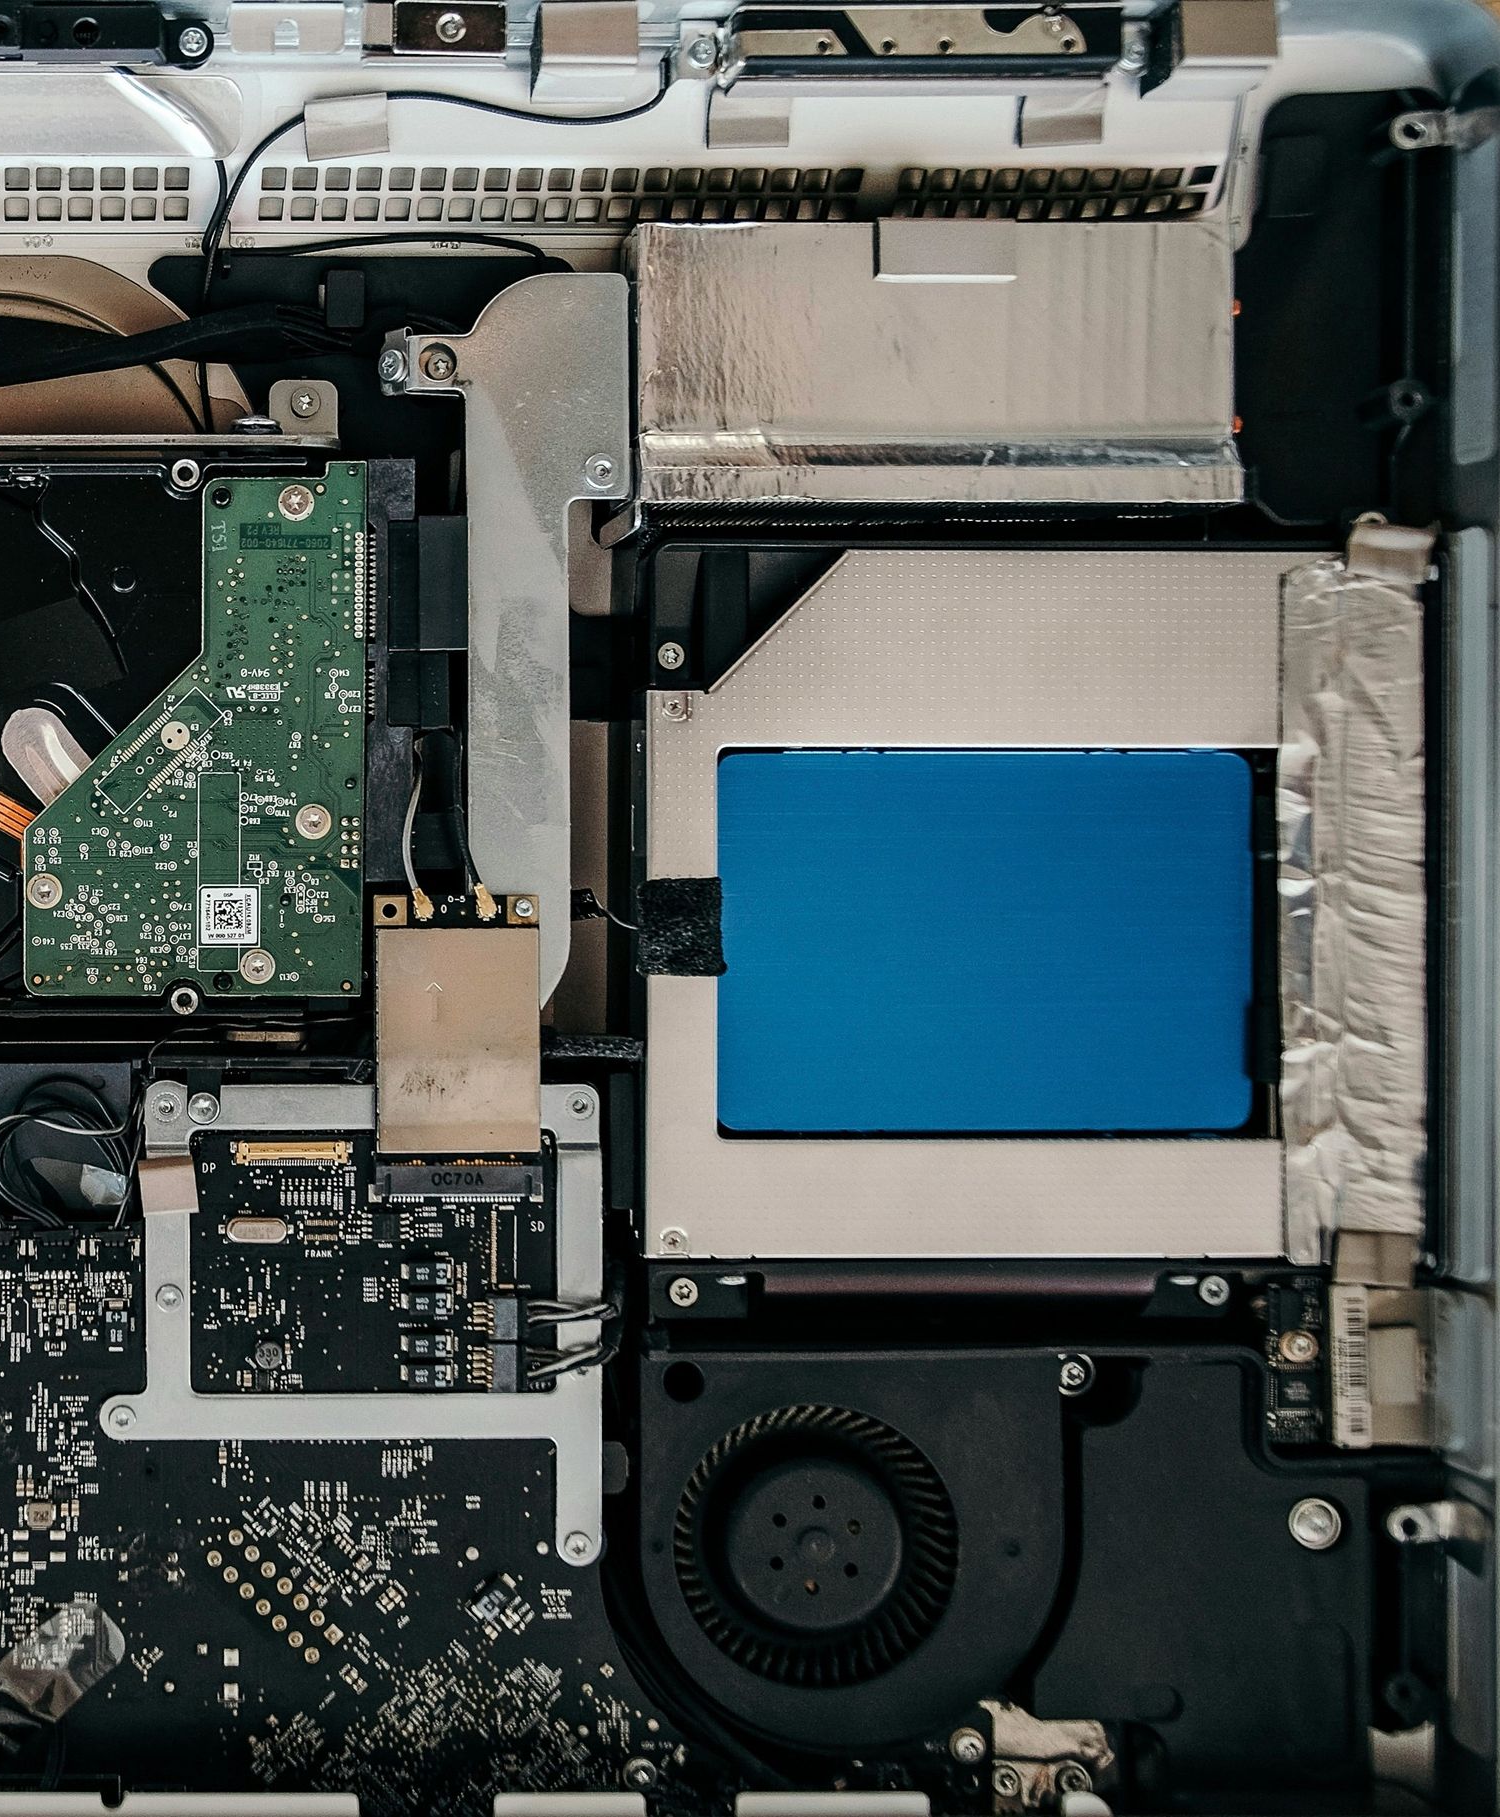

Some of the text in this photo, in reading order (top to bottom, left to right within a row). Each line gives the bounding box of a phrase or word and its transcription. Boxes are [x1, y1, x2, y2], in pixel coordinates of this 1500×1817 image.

[241, 668, 270, 677] 94V-0
[202, 1163, 216, 1173] DP
[530, 1221, 545, 1232] SD
[305, 1250, 332, 1258] FRANK
[79, 1536, 99, 1547] SMC
[78, 1548, 114, 1560] RESET
